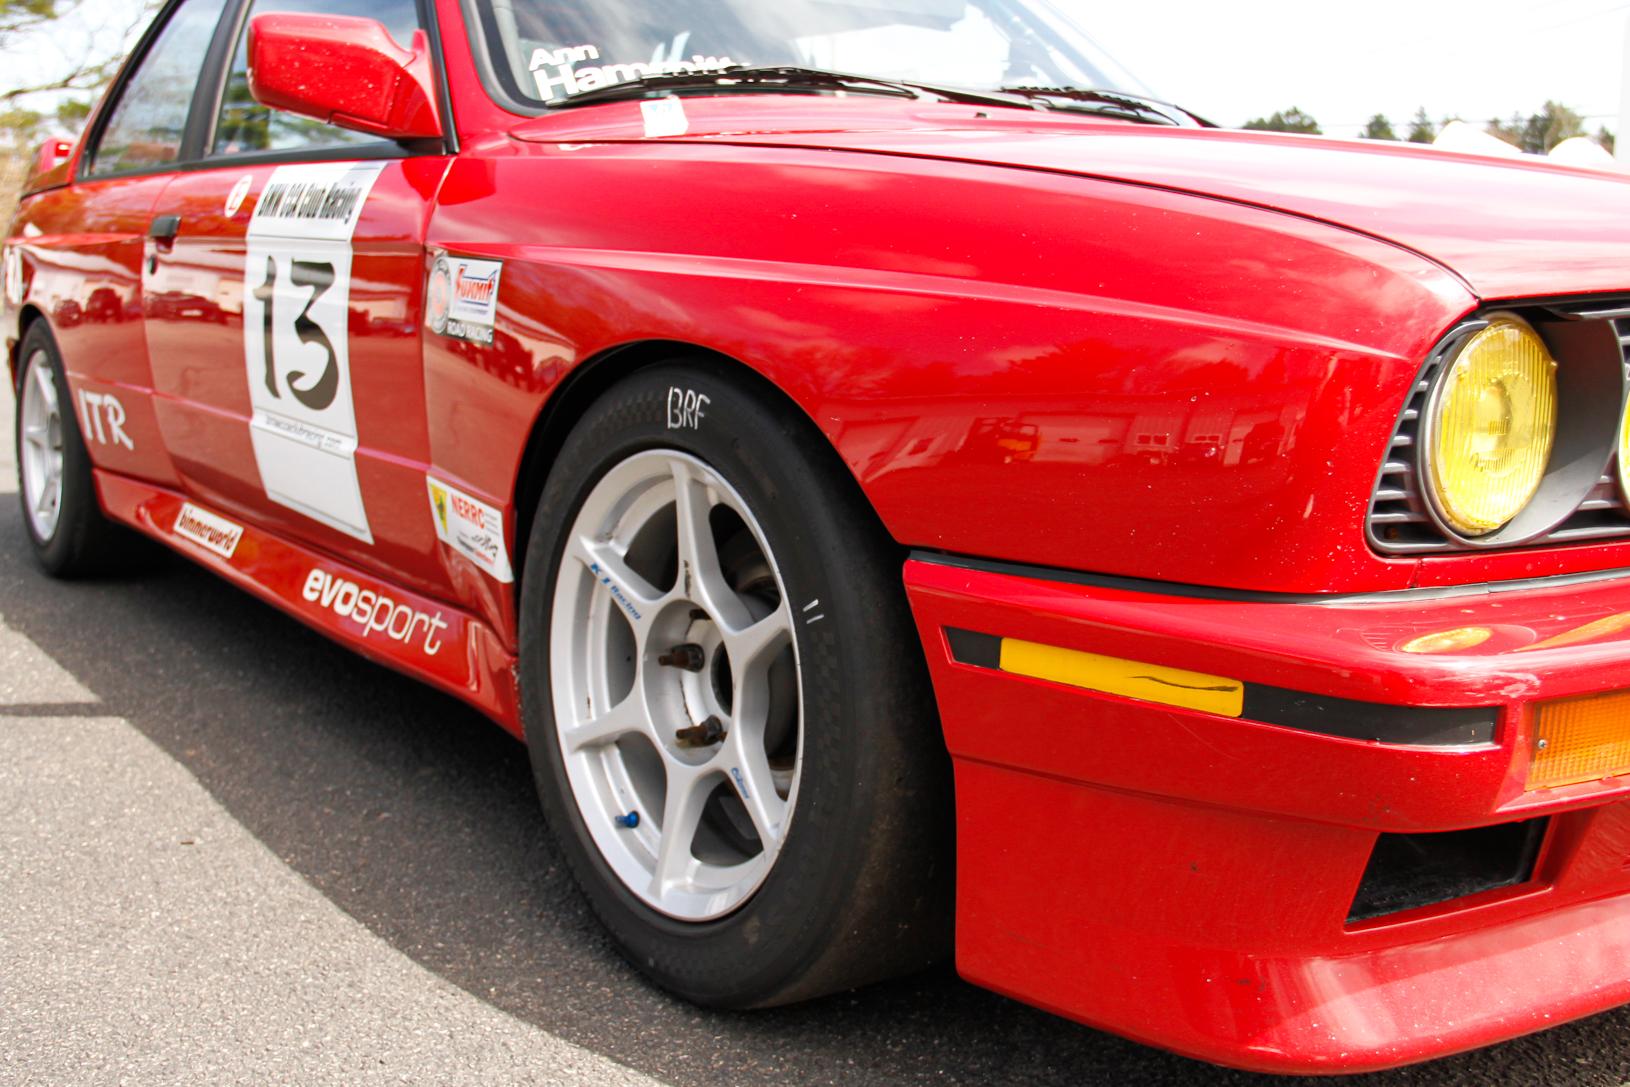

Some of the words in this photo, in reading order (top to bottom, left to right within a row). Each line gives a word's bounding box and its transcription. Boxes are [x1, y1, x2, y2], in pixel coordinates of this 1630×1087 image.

[529, 44, 600, 71] Ann
[258, 183, 289, 217] BMW
[279, 183, 307, 218] CCA
[298, 183, 326, 218] Club
[319, 182, 362, 225] Racing
[253, 255, 340, 411] 13
[447, 320, 466, 337] ROAD
[465, 324, 493, 344] RACING
[78, 388, 134, 451] ITR
[667, 386, 711, 430] BRF
[179, 507, 239, 551] bimmerworld
[452, 493, 485, 529] NERRC
[302, 568, 448, 656] evosport
[610, 585, 642, 620] Racing
